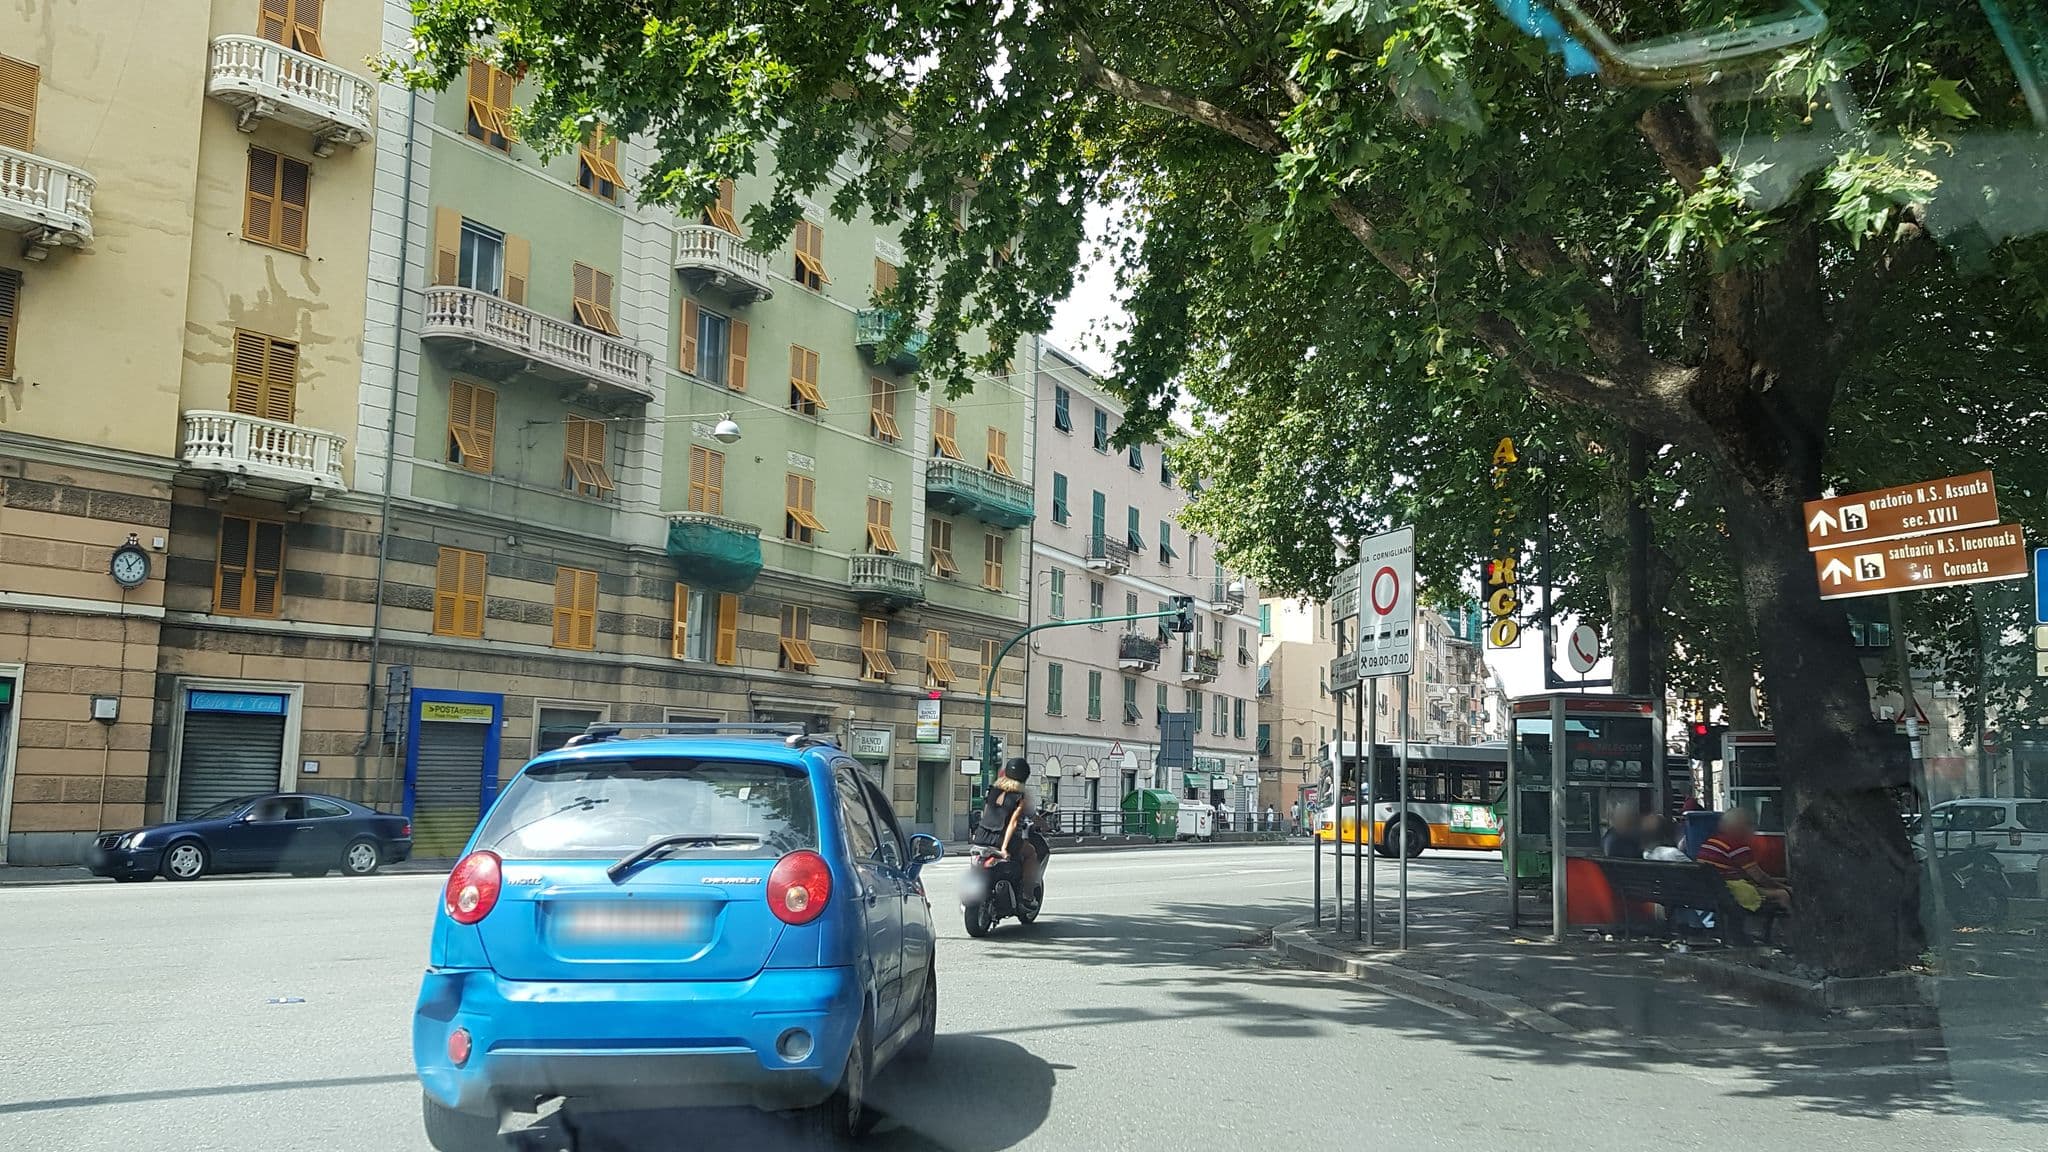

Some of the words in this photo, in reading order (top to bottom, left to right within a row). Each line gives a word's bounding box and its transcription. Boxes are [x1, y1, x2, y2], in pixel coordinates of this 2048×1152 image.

[1869, 491, 1913, 511] oratorio
[1916, 486, 1943, 504] N.S.
[1945, 479, 1989, 499] Assunta
[1902, 506, 1958, 528] sec.XVII
[1372, 545, 1412, 561] CORNIGLIANO
[1889, 541, 1935, 560] santuario
[1937, 538, 1959, 555] N.S.
[1961, 531, 2016, 551] Incoronata
[1922, 564, 1933, 579] di
[1943, 559, 1989, 577] Coronata
[1368, 653, 1409, 668] 09.00-17.00
[858, 745, 884, 753] METALLI
[861, 737, 882, 745] BANCO
